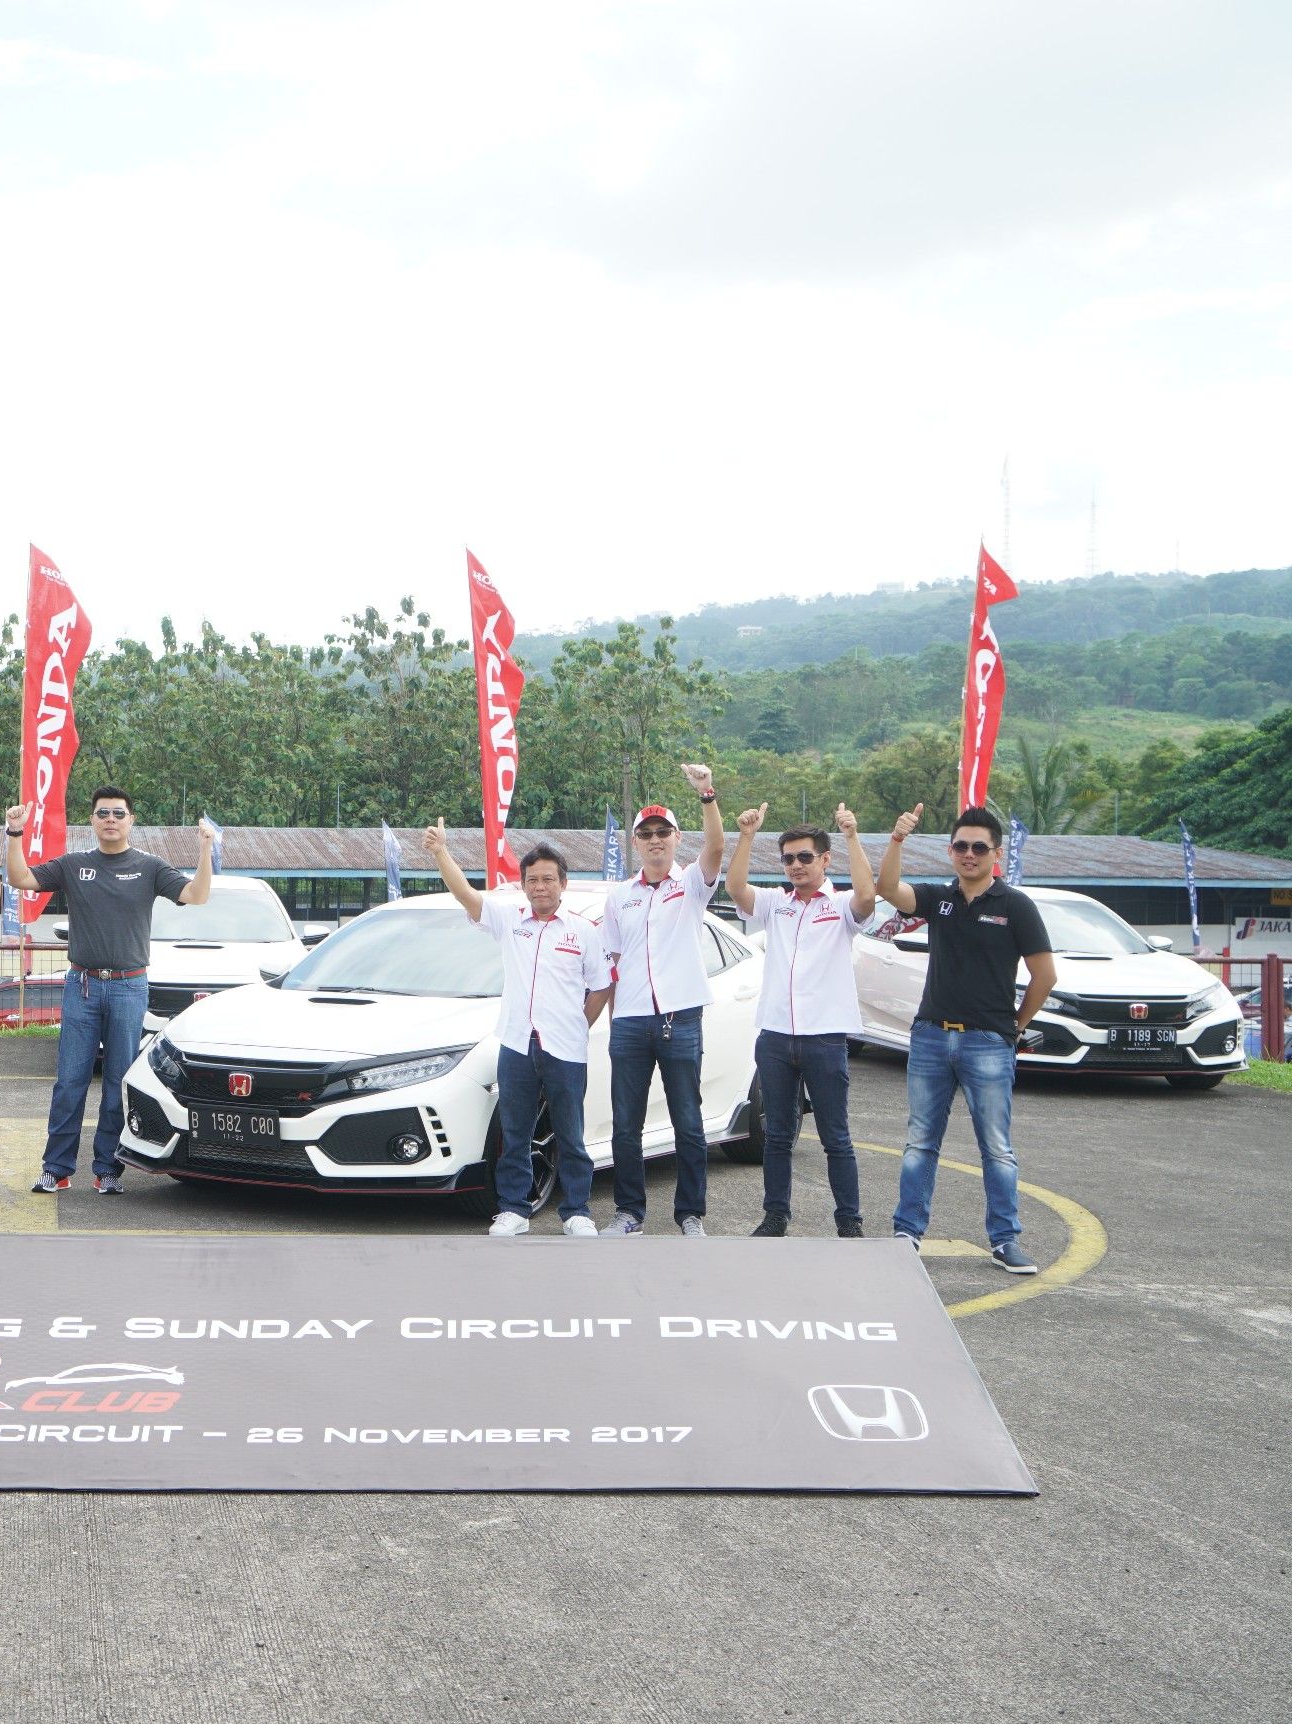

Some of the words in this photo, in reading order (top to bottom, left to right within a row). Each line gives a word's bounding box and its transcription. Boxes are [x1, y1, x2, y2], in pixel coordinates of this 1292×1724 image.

[28, 602, 77, 858] HONDA
[1110, 1029, 1117, 1041] B
[1128, 1029, 1151, 1042] 1189
[1157, 1030, 1175, 1042] SGN
[191, 1111, 199, 1128] B
[211, 1112, 241, 1133] 1582
[48, 1316, 97, 1339] &
[123, 1317, 374, 1339] SUNDAY
[400, 1317, 632, 1339] CIRCUIT
[659, 1316, 898, 1342] DRIVING
[21, 1391, 181, 1413] CLUB
[246, 1426, 304, 1443] 26
[323, 1427, 571, 1444] NOVEMBER
[591, 1426, 693, 1443] 2017
